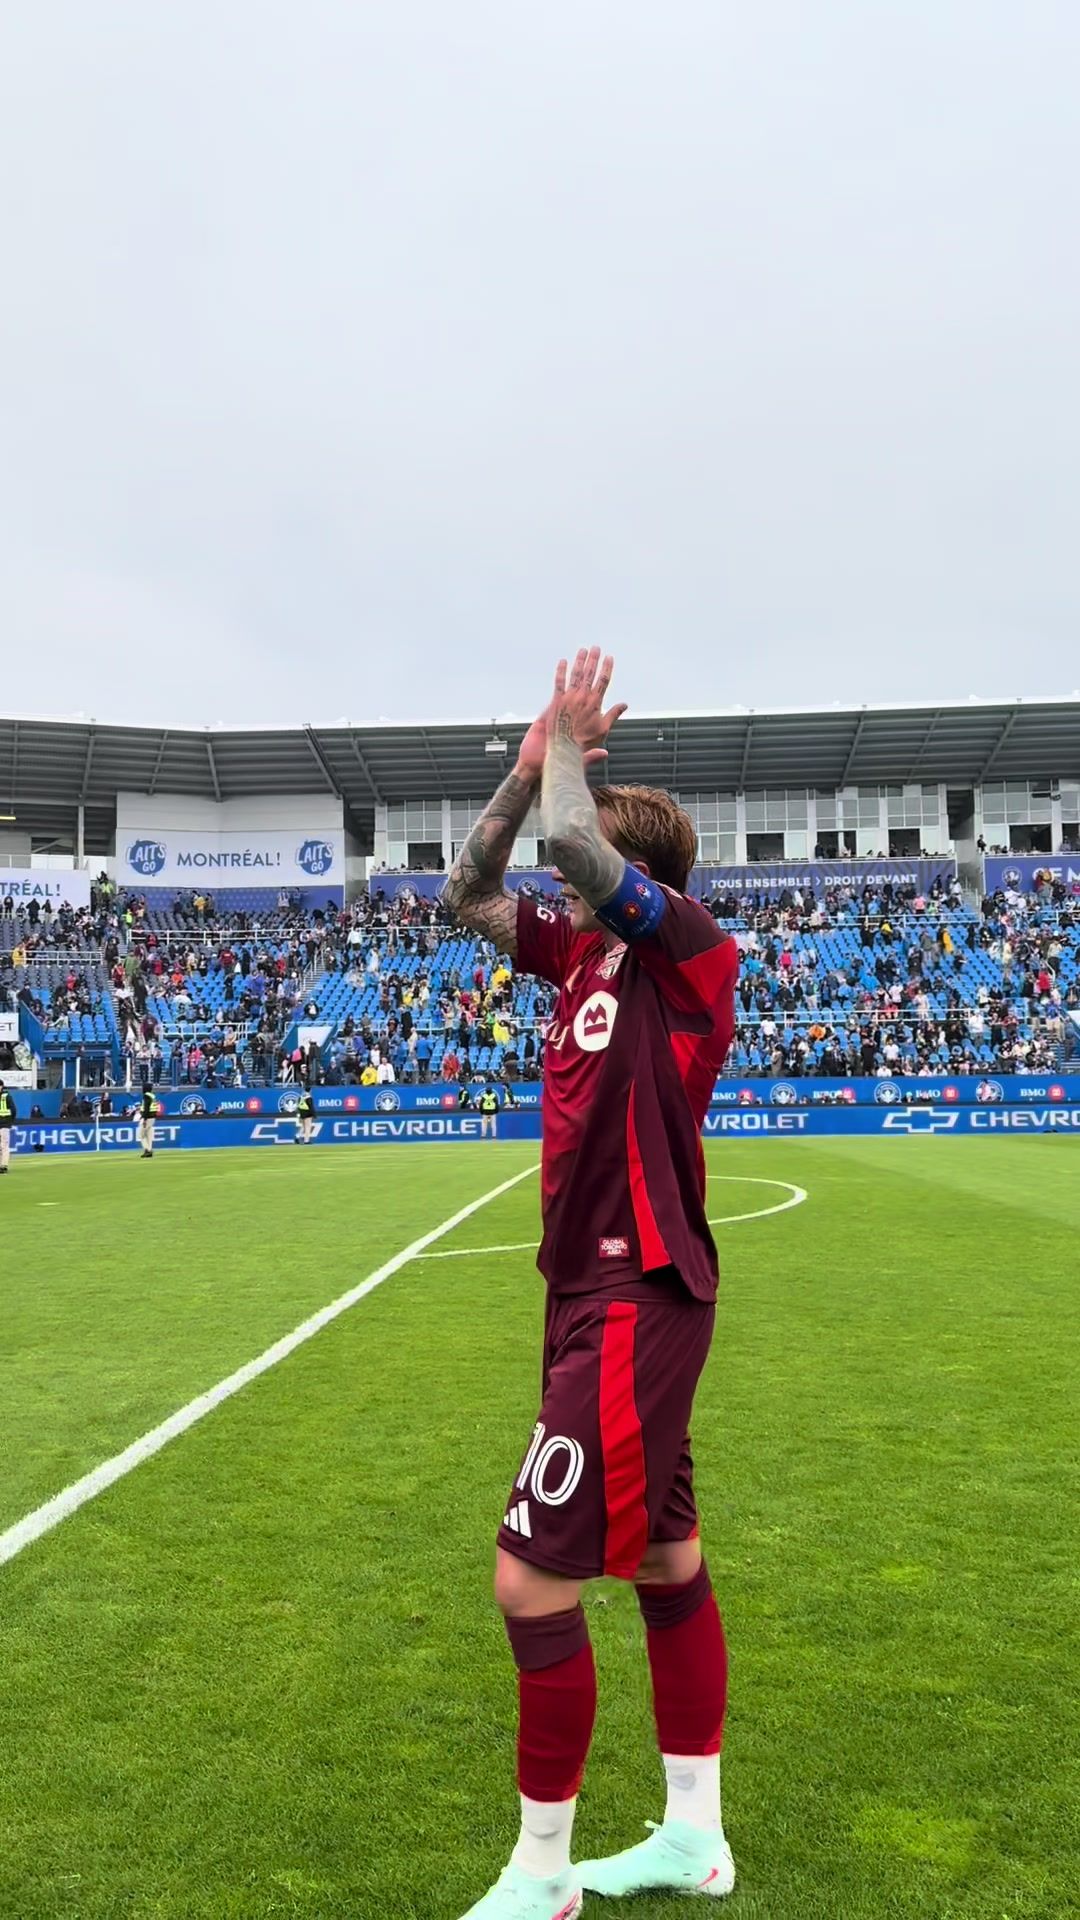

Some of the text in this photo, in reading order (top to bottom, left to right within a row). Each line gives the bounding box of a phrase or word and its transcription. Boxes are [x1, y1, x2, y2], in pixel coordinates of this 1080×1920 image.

[142, 861, 156, 872] GO
[310, 861, 324, 872] GO
[711, 874, 918, 889] TOUS ENSEMBLE DROIT DEVANT
[712, 1092, 736, 1100] BMO
[1020, 1088, 1046, 1097] BMO
[221, 1101, 244, 1110] BMO
[318, 1099, 342, 1108] BMO
[416, 1097, 440, 1106] BMO
[333, 1119, 483, 1137] CHEVROLE
[516, 1422, 584, 1506] 10
